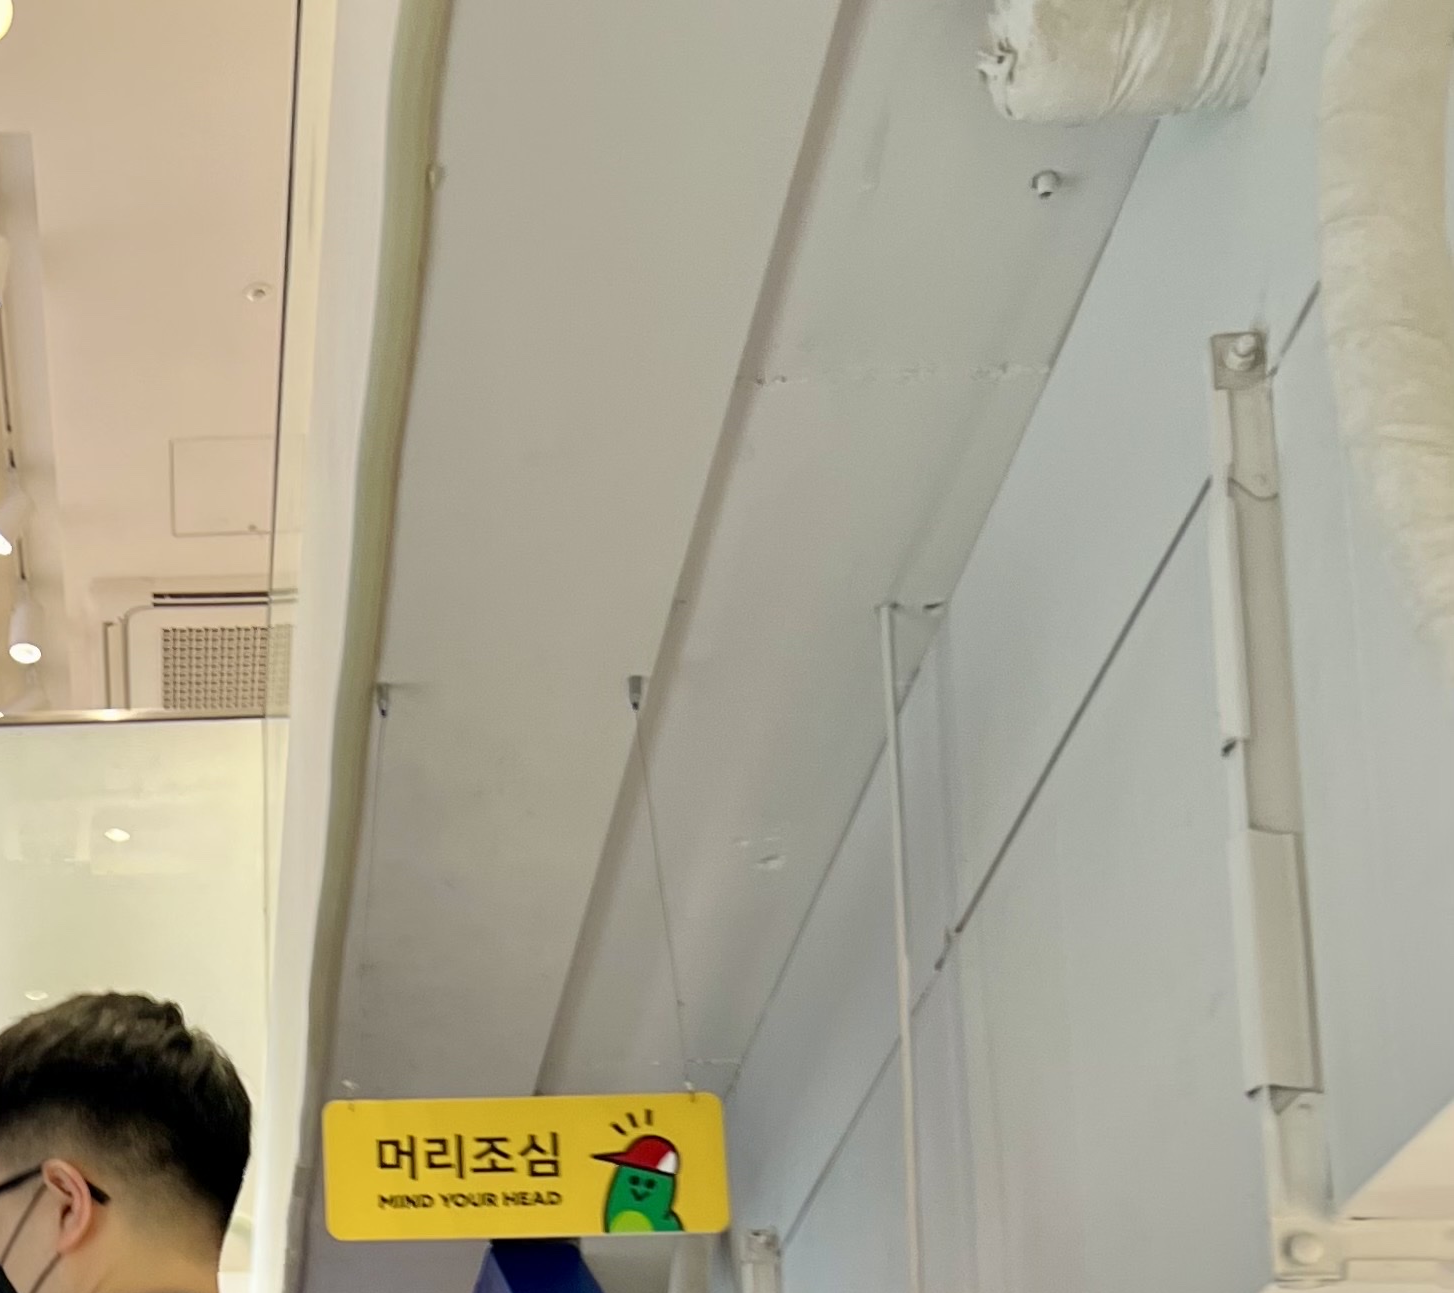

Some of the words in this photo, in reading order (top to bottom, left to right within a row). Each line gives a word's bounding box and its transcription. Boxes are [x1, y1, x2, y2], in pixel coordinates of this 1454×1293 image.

[375, 1131, 561, 1181] 머리조심
[378, 1193, 435, 1210] MIND
[439, 1191, 499, 1208] YOUR
[501, 1190, 563, 1207] HEAD
